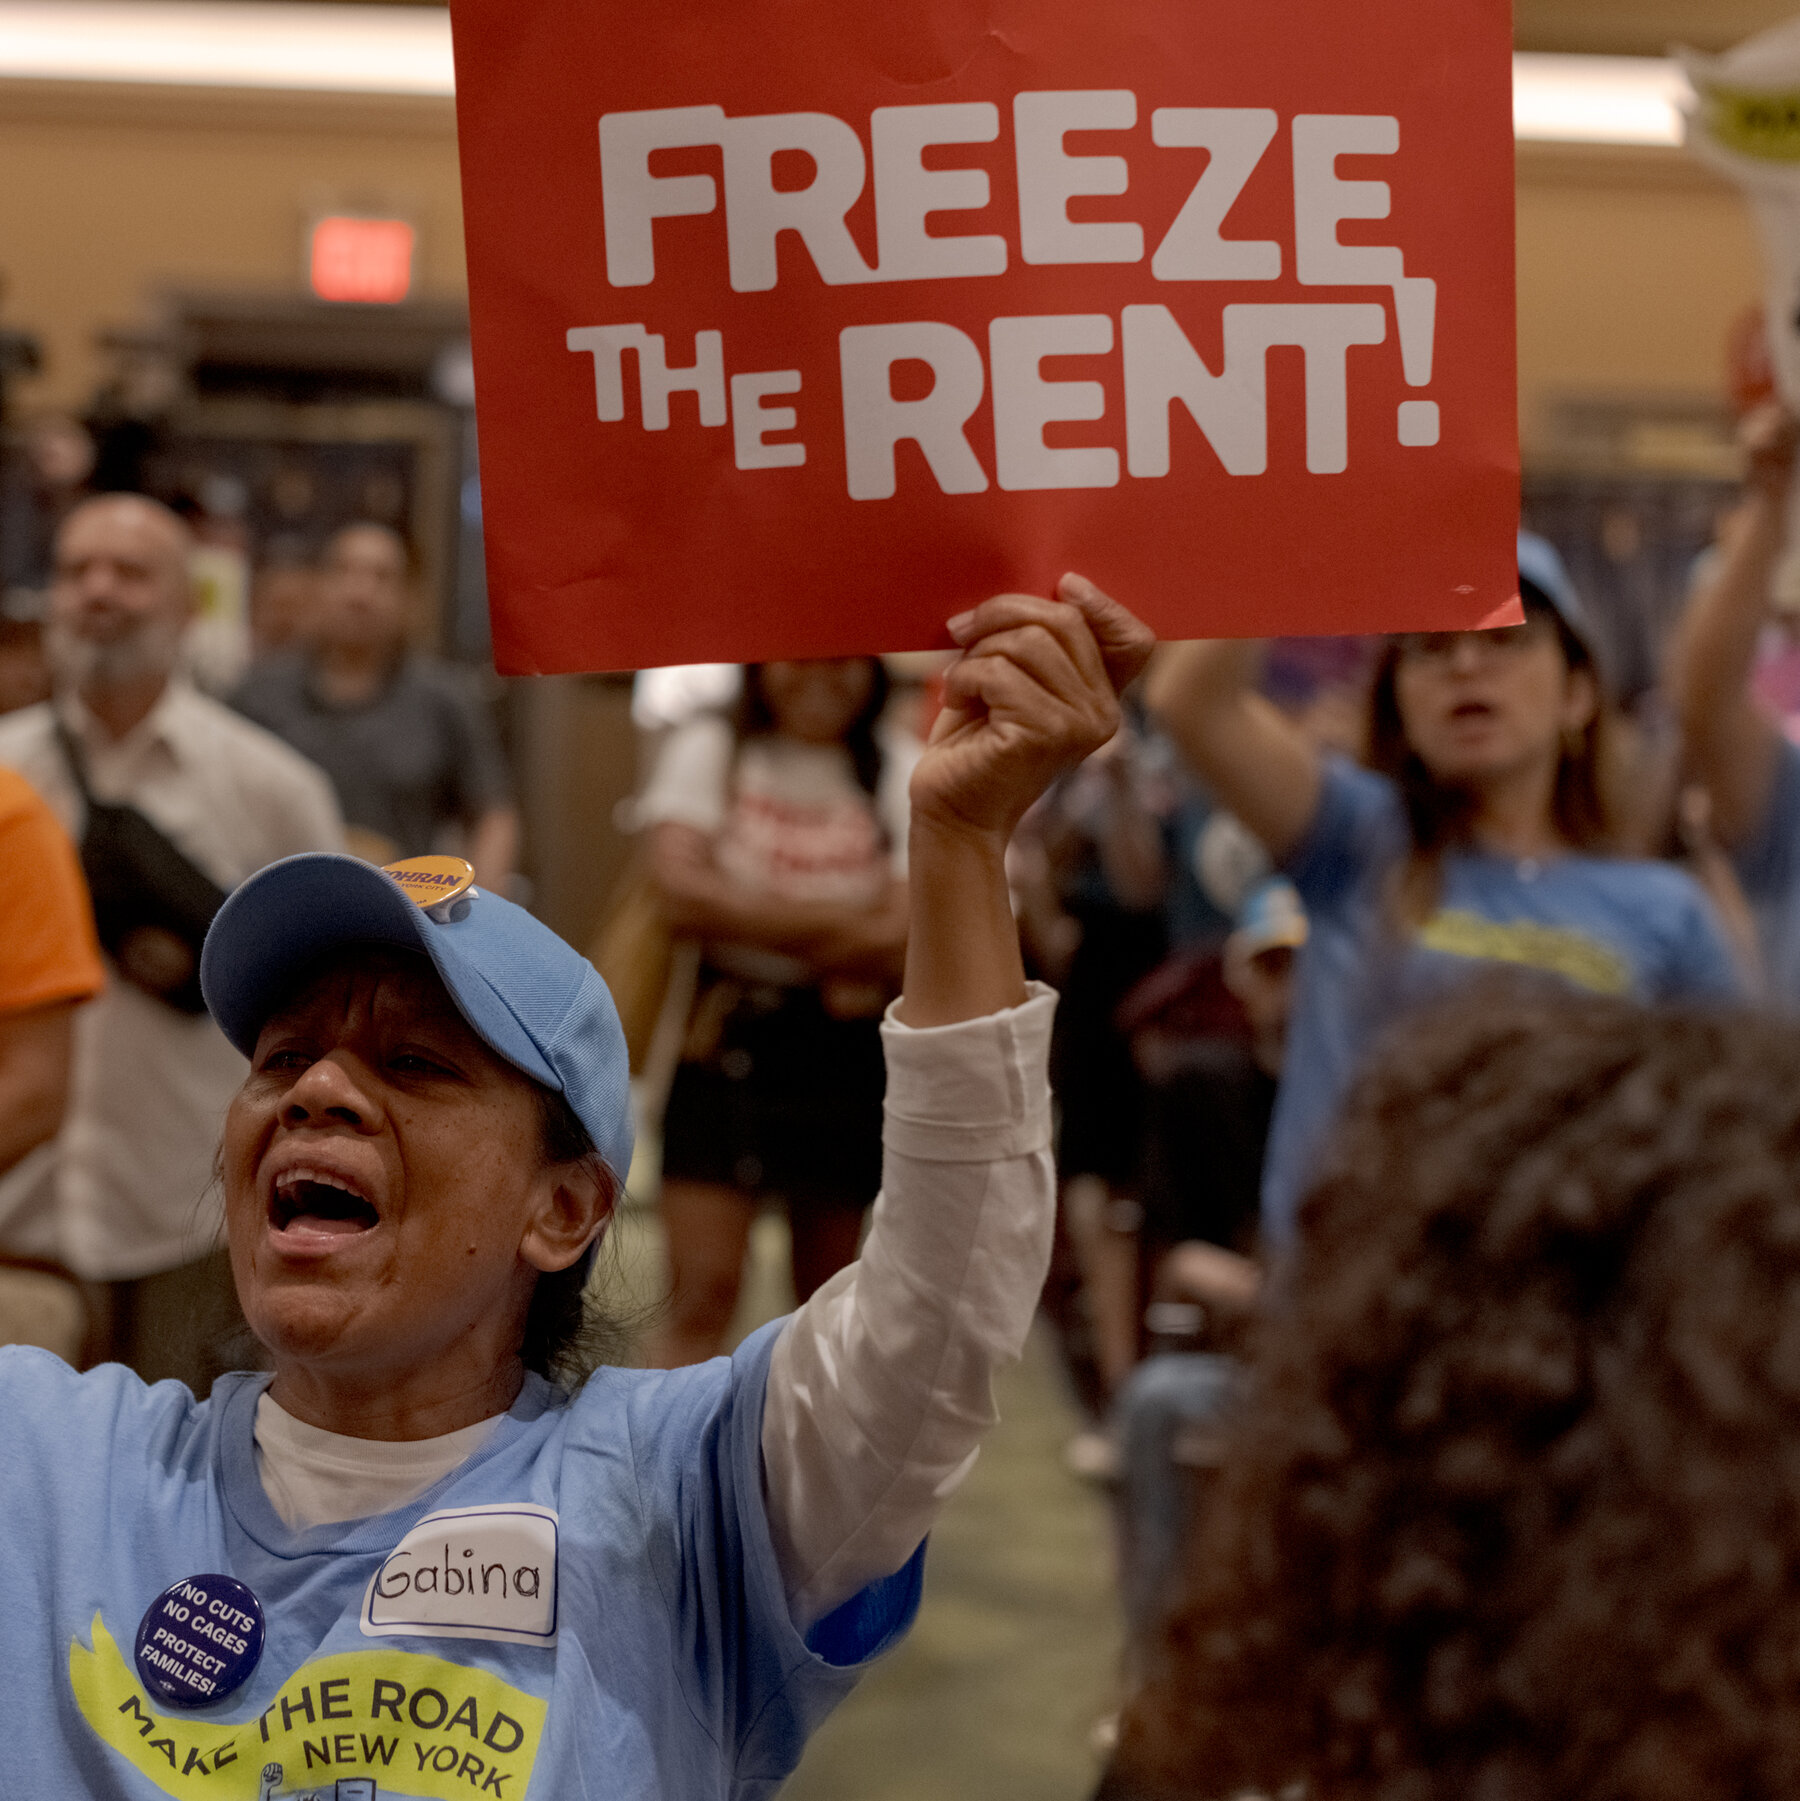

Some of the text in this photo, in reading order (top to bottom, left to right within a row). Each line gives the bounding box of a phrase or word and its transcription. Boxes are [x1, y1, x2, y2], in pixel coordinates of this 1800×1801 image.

[598, 89, 1404, 293] FREEZE
[566, 277, 1440, 501] THE RENT!
[385, 870, 464, 887] OHRAN
[376, 1543, 540, 1599] Gabina
[162, 1599, 248, 1655] NO CAGES
[180, 1583, 256, 1633] NO CUTS
[140, 1644, 217, 1696] FAMILIES!
[153, 1627, 227, 1675] PROTECT
[118, 1678, 524, 1777] MAKE THE ROAD
[302, 1733, 513, 1799] NEW YORK
